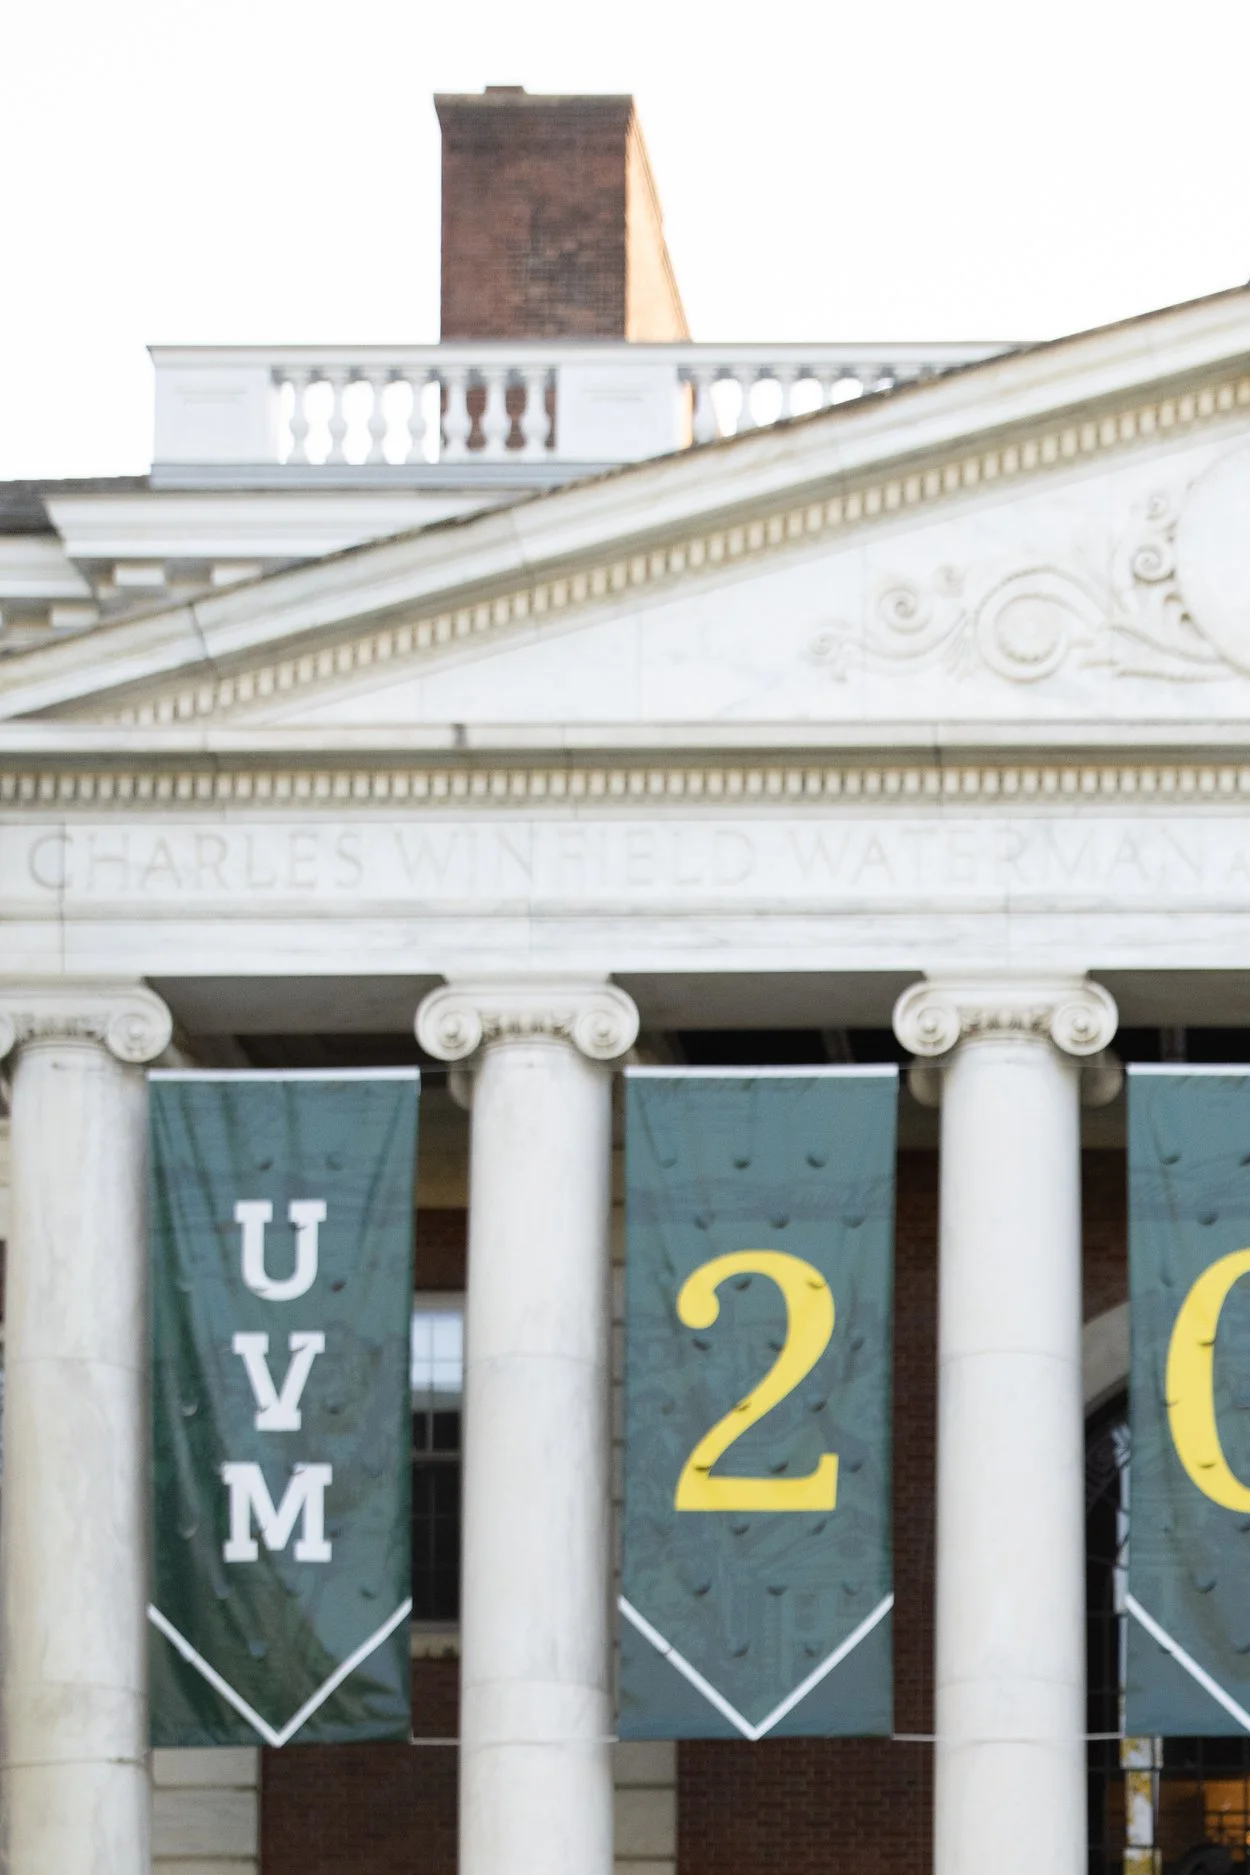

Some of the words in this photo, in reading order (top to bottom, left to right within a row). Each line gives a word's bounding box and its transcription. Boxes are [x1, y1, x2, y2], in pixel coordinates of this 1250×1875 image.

[26, 830, 365, 893] CHARLES
[393, 826, 760, 890] WINFIELD
[786, 824, 1204, 887] WATERMAN
